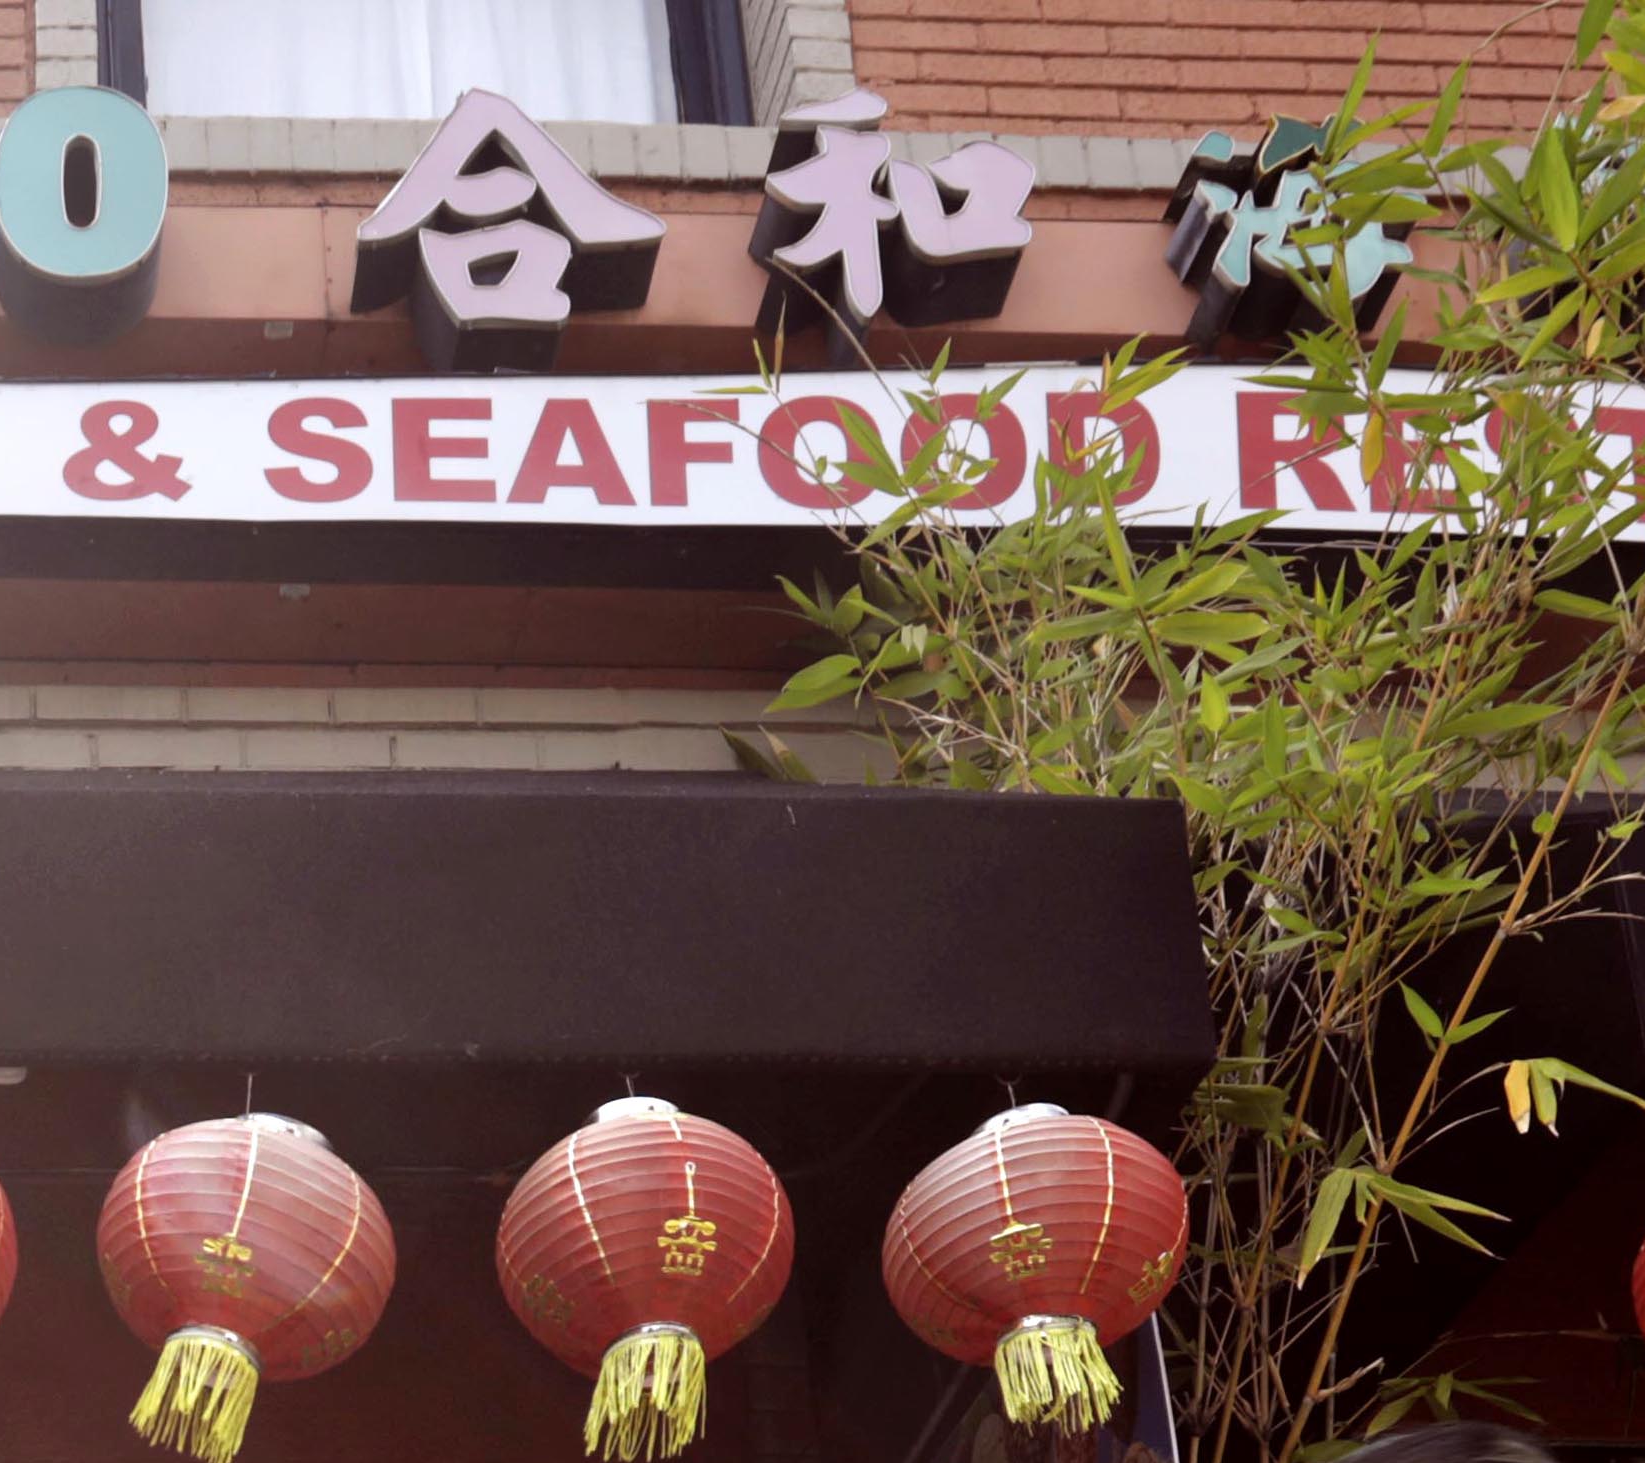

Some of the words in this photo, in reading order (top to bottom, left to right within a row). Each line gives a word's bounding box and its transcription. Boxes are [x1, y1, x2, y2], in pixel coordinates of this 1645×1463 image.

[357, 86, 1035, 330] 合和
[61, 401, 191, 503] &
[264, 393, 1162, 512] SEAFOOD
